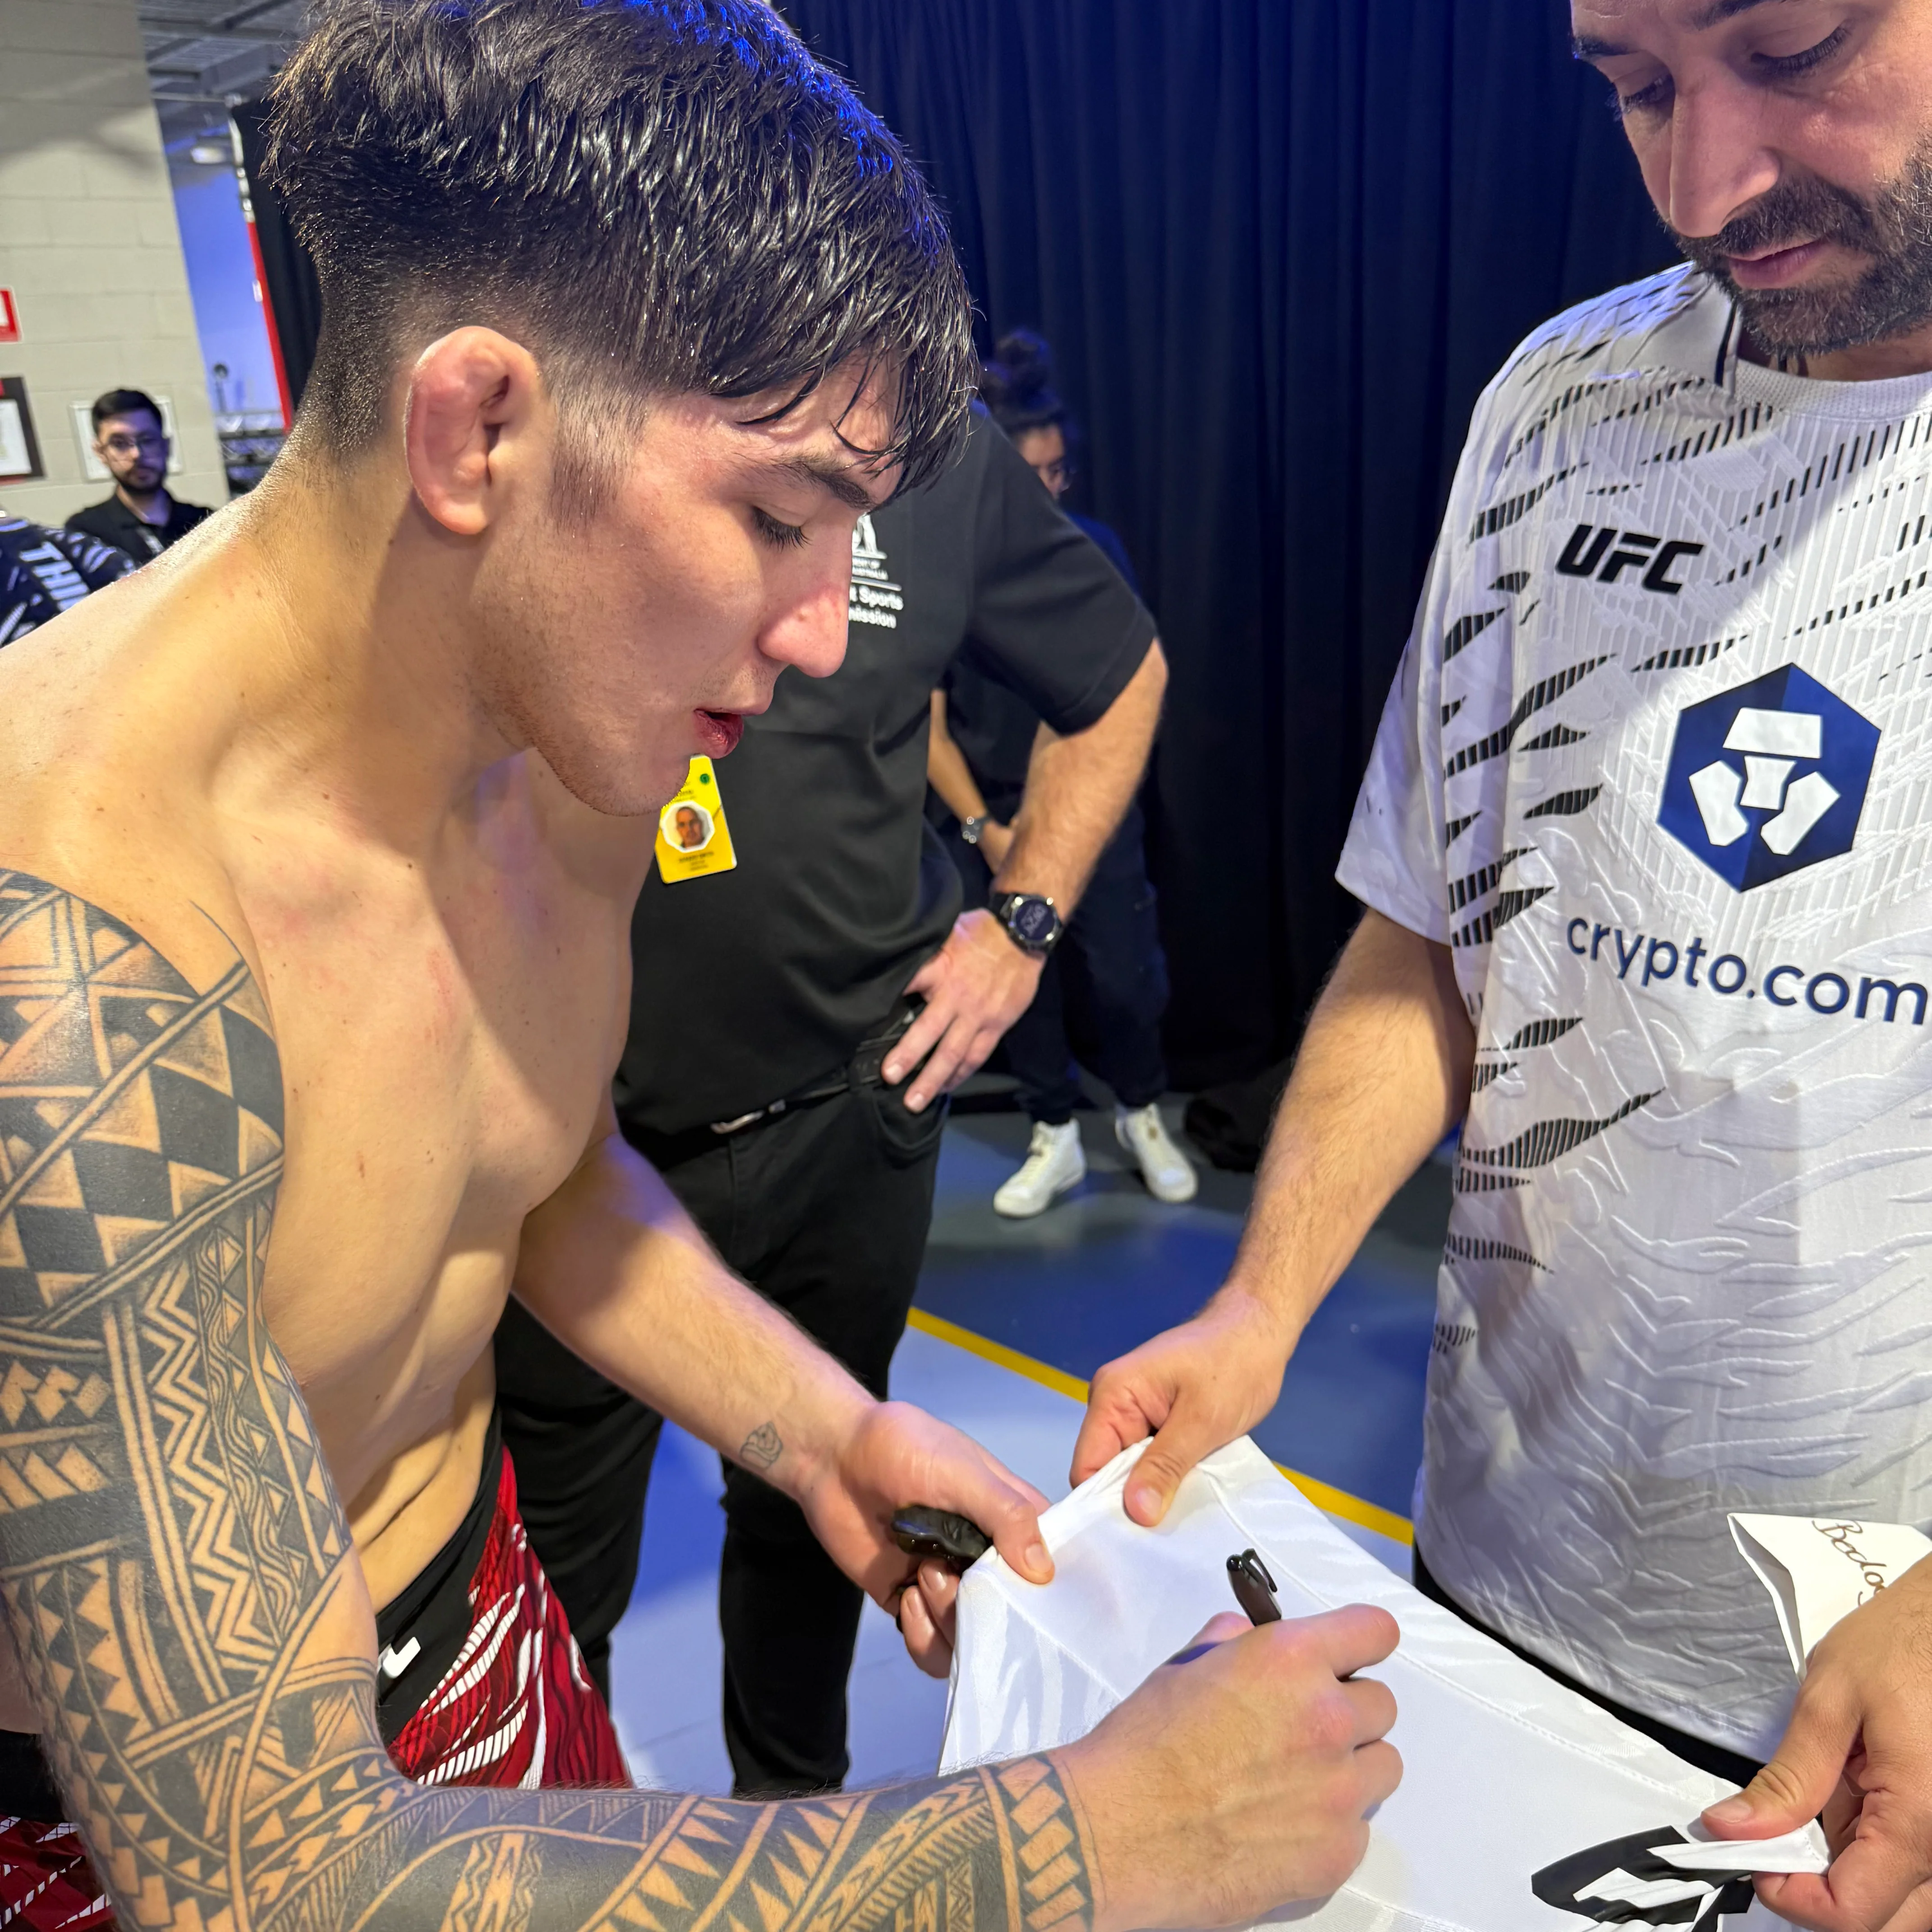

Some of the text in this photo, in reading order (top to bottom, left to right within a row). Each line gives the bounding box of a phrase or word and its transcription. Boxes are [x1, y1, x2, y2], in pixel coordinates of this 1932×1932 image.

[1555, 524, 1704, 594] UFC
[859, 585, 904, 611] Sports
[1566, 917, 1928, 1025] crypto.com
